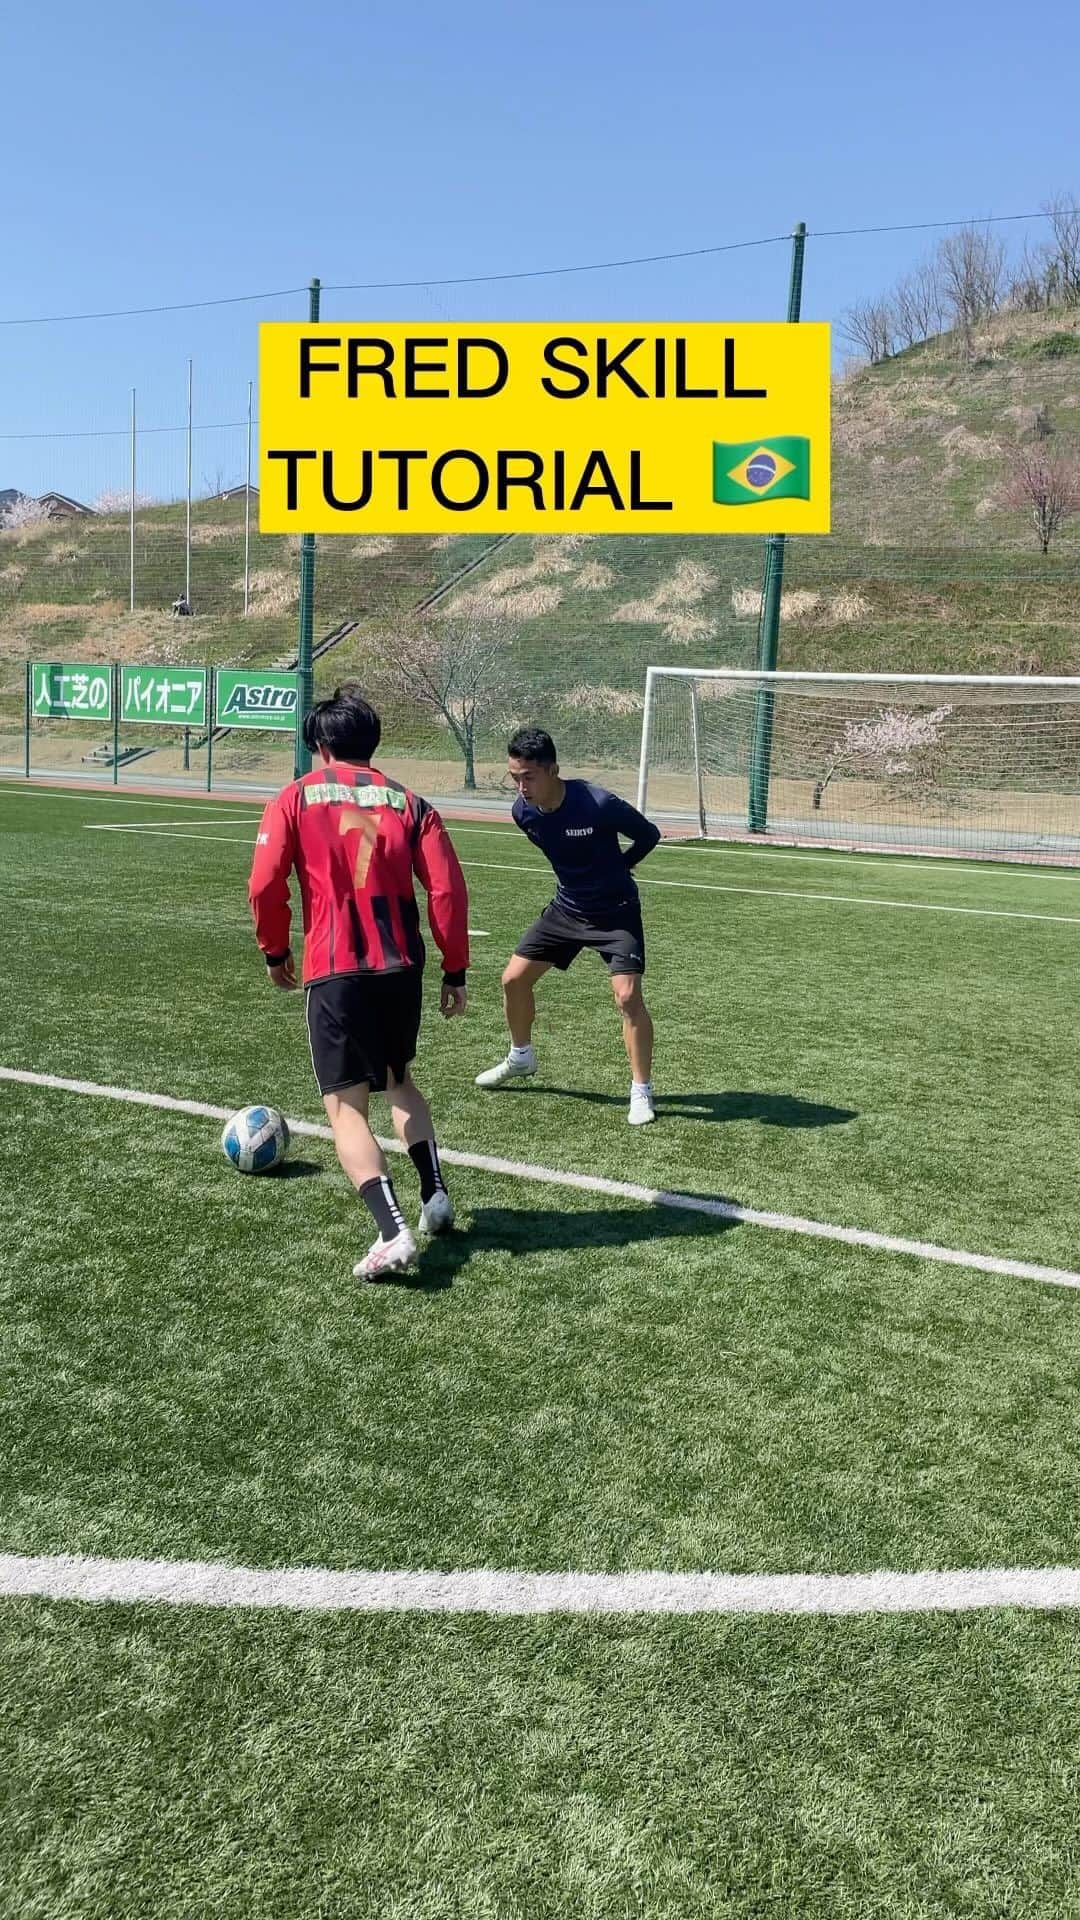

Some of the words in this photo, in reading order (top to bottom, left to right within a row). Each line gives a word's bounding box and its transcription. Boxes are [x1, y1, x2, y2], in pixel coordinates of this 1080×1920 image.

[35, 672, 108, 709] 人工芝の
[124, 675, 203, 715] パイオニア
[222, 684, 297, 714] Astro
[339, 810, 382, 889] 7
